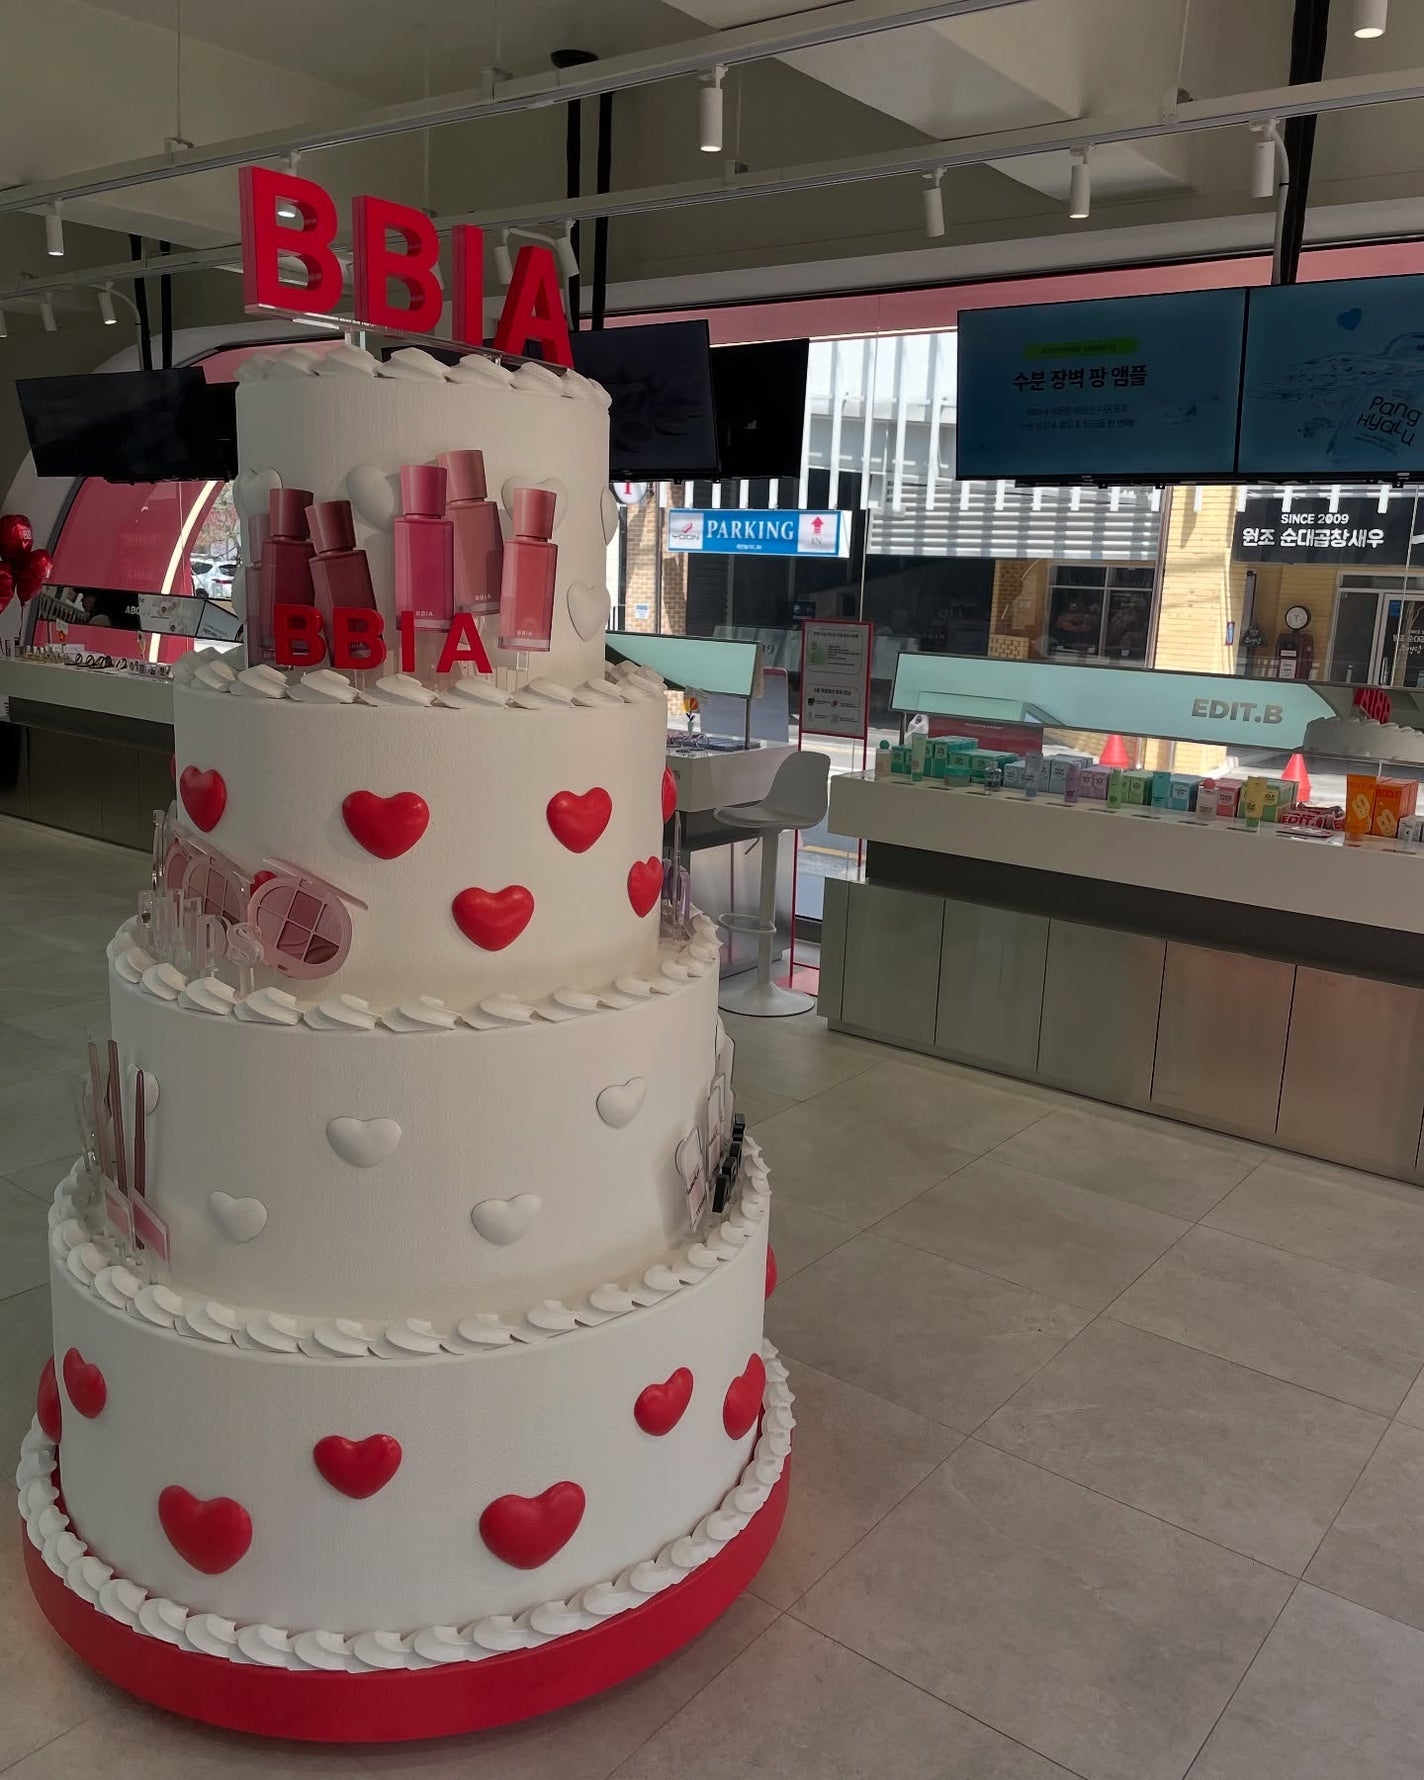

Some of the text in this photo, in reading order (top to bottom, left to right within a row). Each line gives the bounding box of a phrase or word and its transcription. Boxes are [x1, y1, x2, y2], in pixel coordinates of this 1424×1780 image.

[239, 166, 574, 369] BBIA
[1012, 365, 1147, 391] 수분 장벽 팡 앰플
[1368, 396, 1422, 427] Pang
[707, 520, 794, 540] PARKING
[1280, 513, 1350, 525] SINCE 2009
[1242, 527, 1385, 549] 원조 순대곱창새우
[274, 603, 492, 673] BBIA
[1191, 697, 1283, 724] EDIT.B
